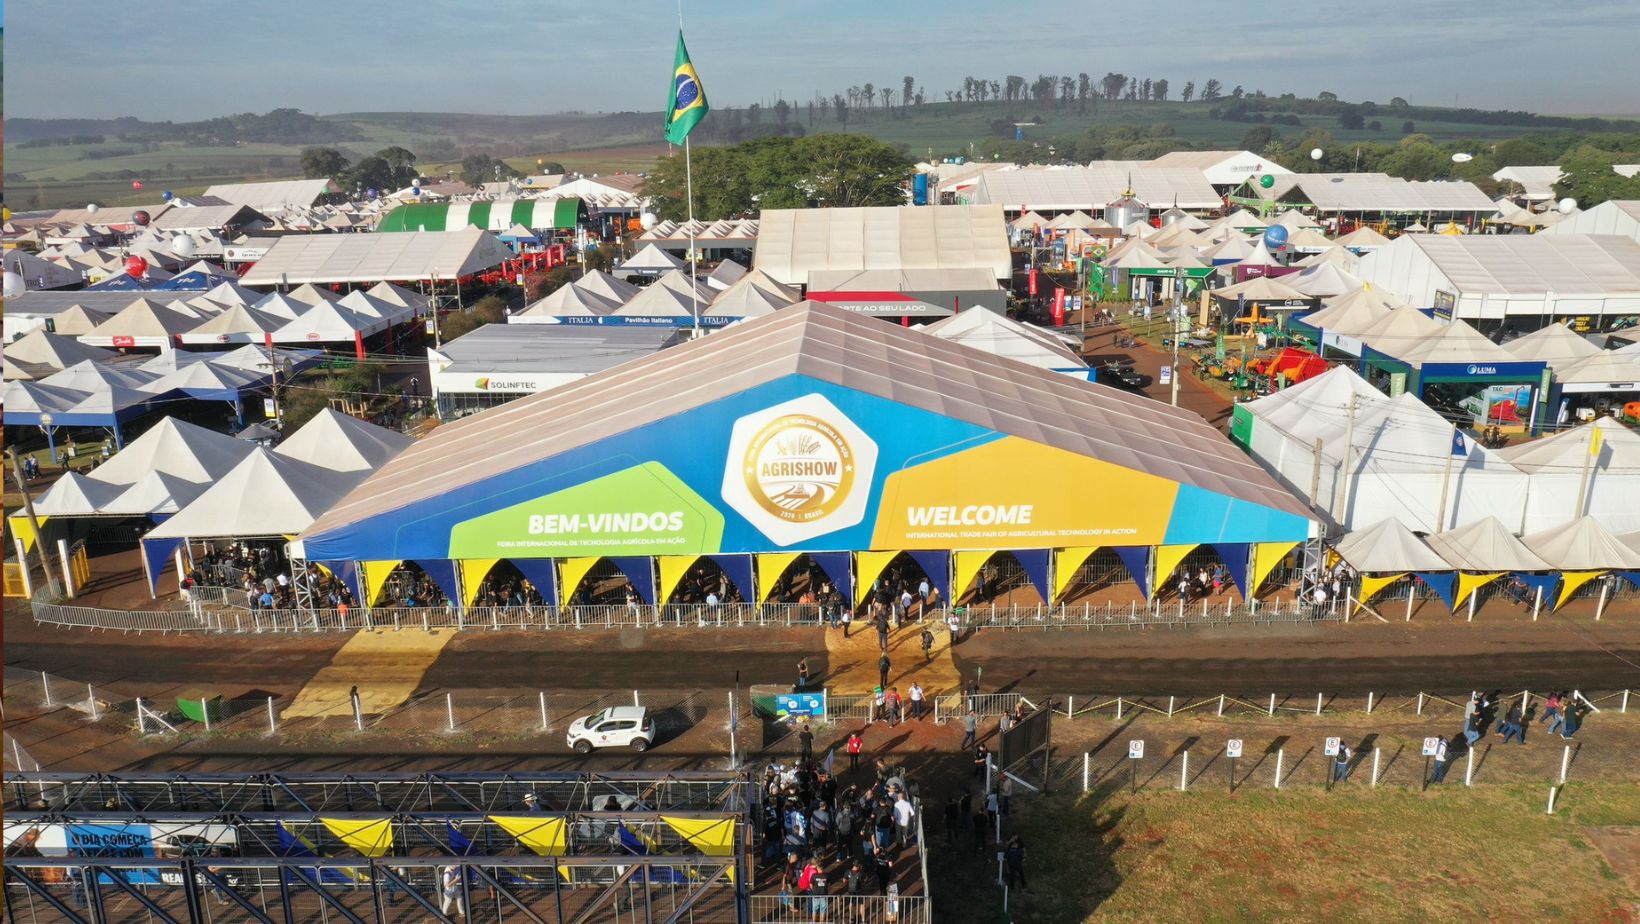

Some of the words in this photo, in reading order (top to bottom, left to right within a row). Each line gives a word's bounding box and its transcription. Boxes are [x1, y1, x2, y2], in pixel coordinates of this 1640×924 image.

[762, 461, 838, 477] AGRISHOW
[528, 511, 684, 534] BEM-VINDOS
[907, 505, 1033, 526] WELCOME
[667, 537, 686, 545] AÇÃO
[82, 834, 101, 845] DIA
